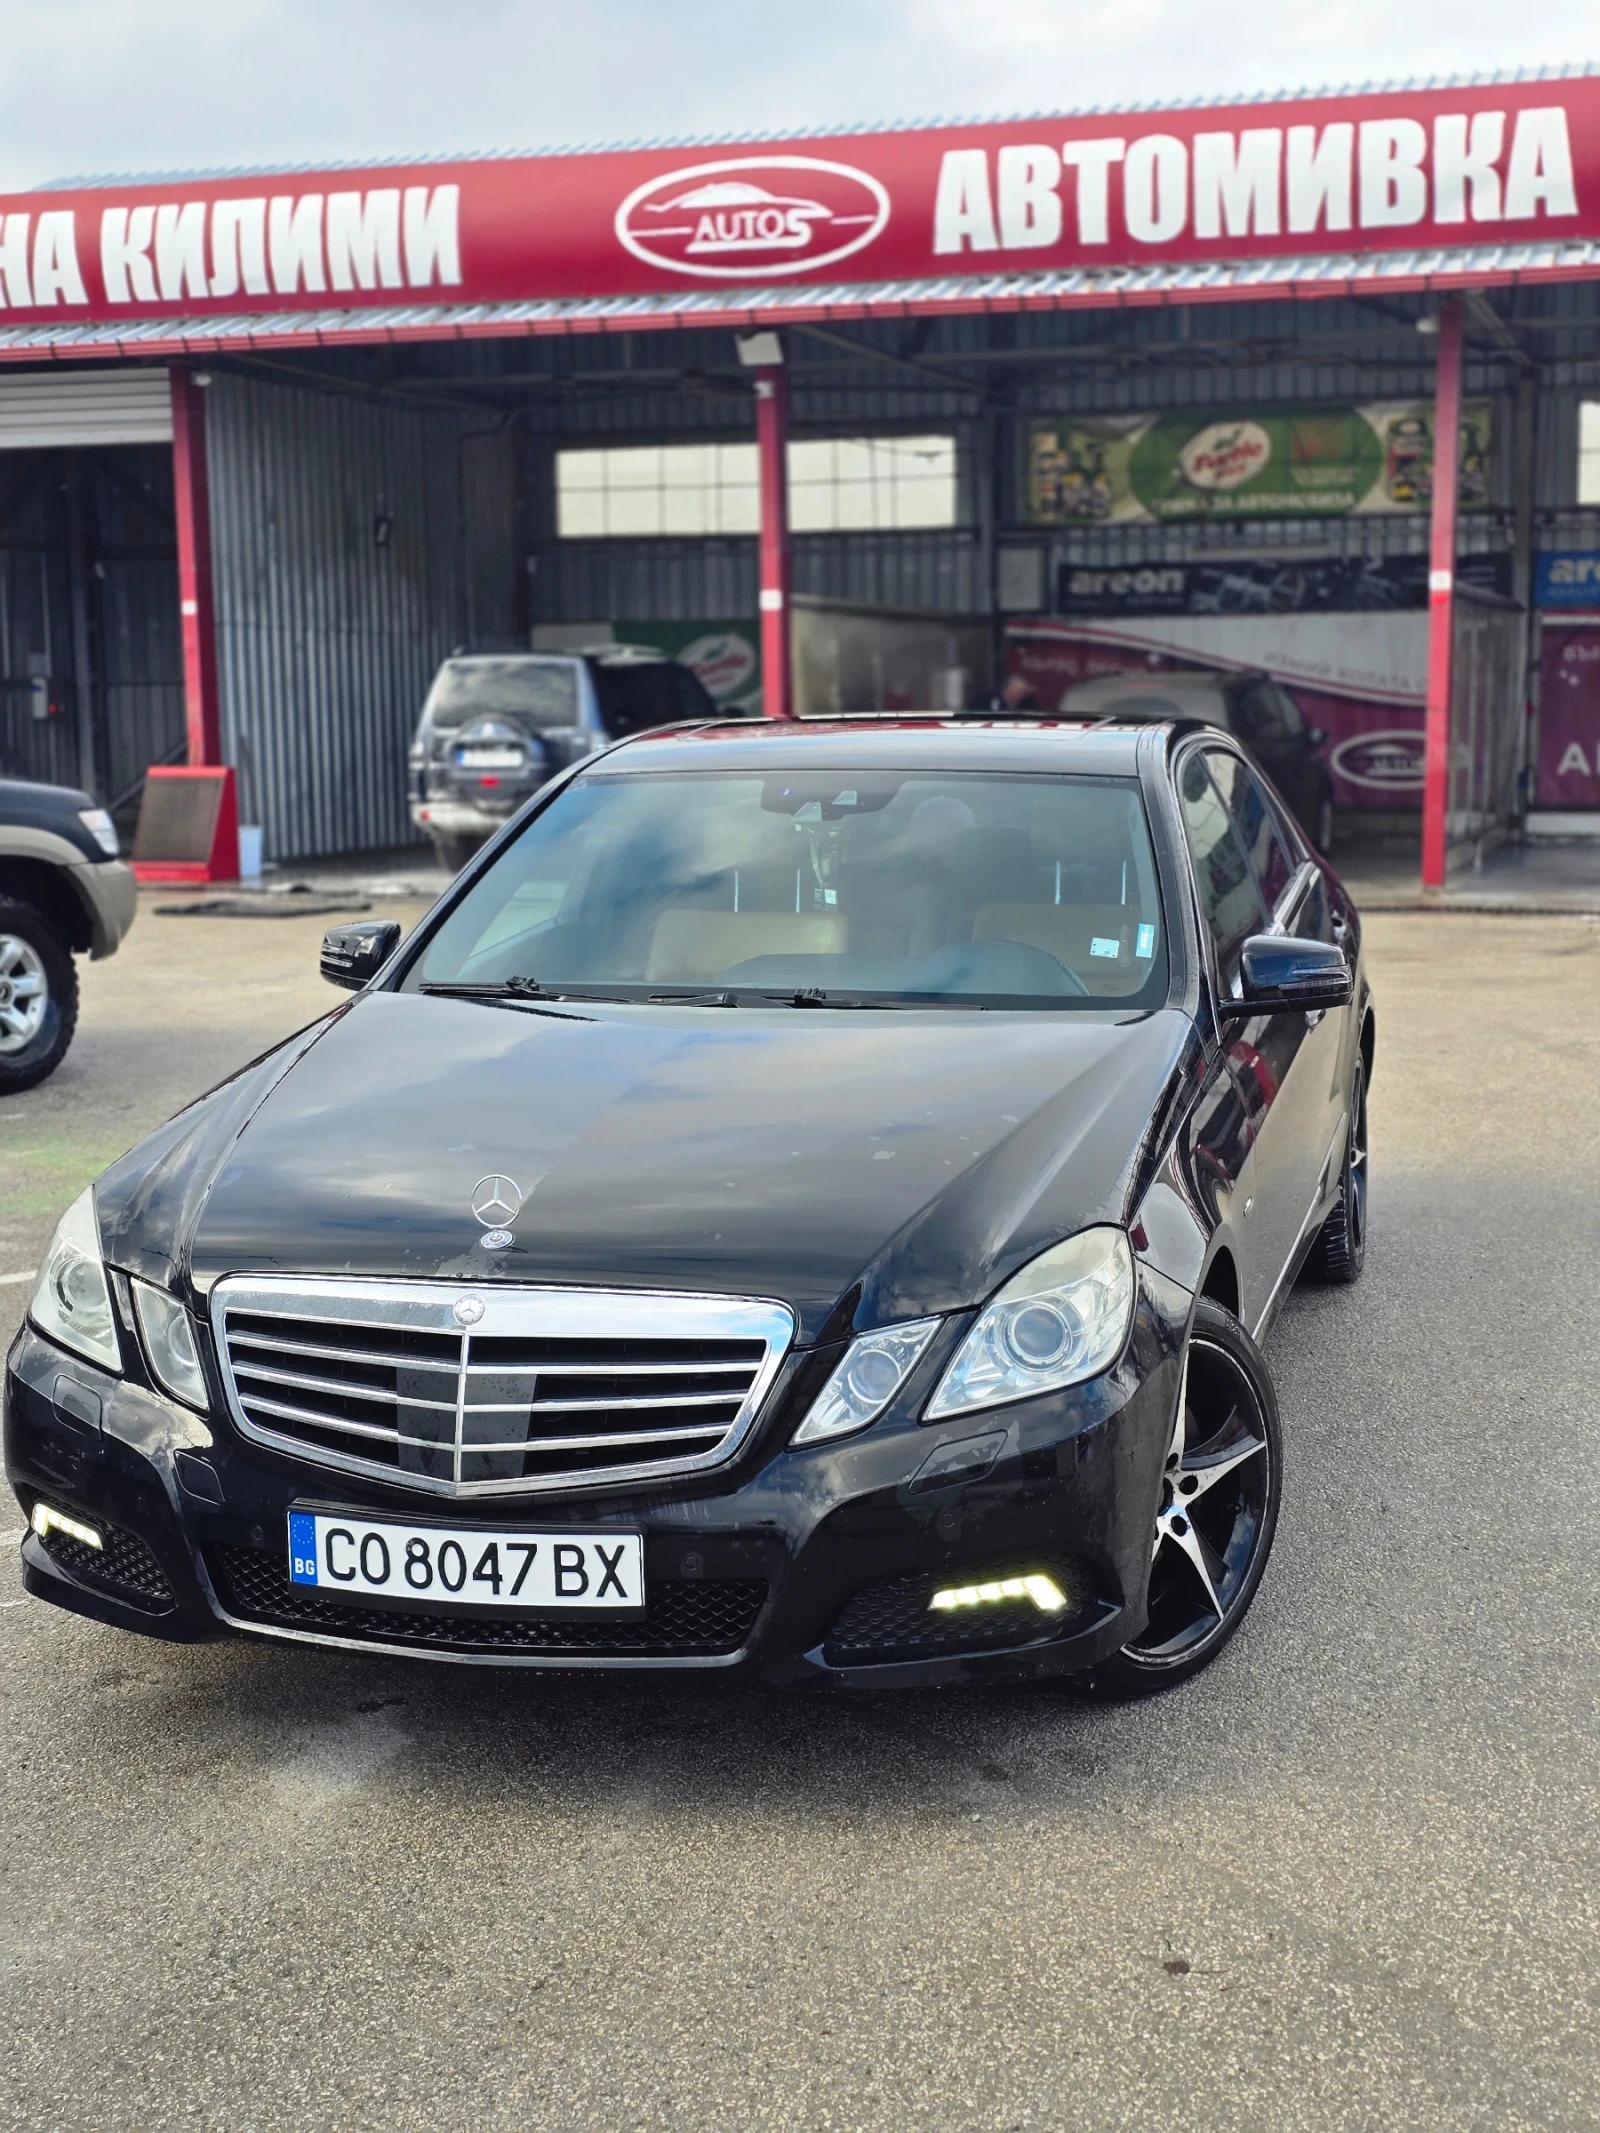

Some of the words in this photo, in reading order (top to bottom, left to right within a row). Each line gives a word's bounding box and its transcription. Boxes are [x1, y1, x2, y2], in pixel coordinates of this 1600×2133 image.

[933, 107, 1578, 254] АВТОМИВКА
[101, 185, 461, 303] КИЛИМИ
[1069, 569, 1184, 595] areon
[295, 1558, 315, 1576] BG
[325, 1528, 391, 1585] CO
[404, 1537, 538, 1596] 8047
[553, 1544, 628, 1598] BX
